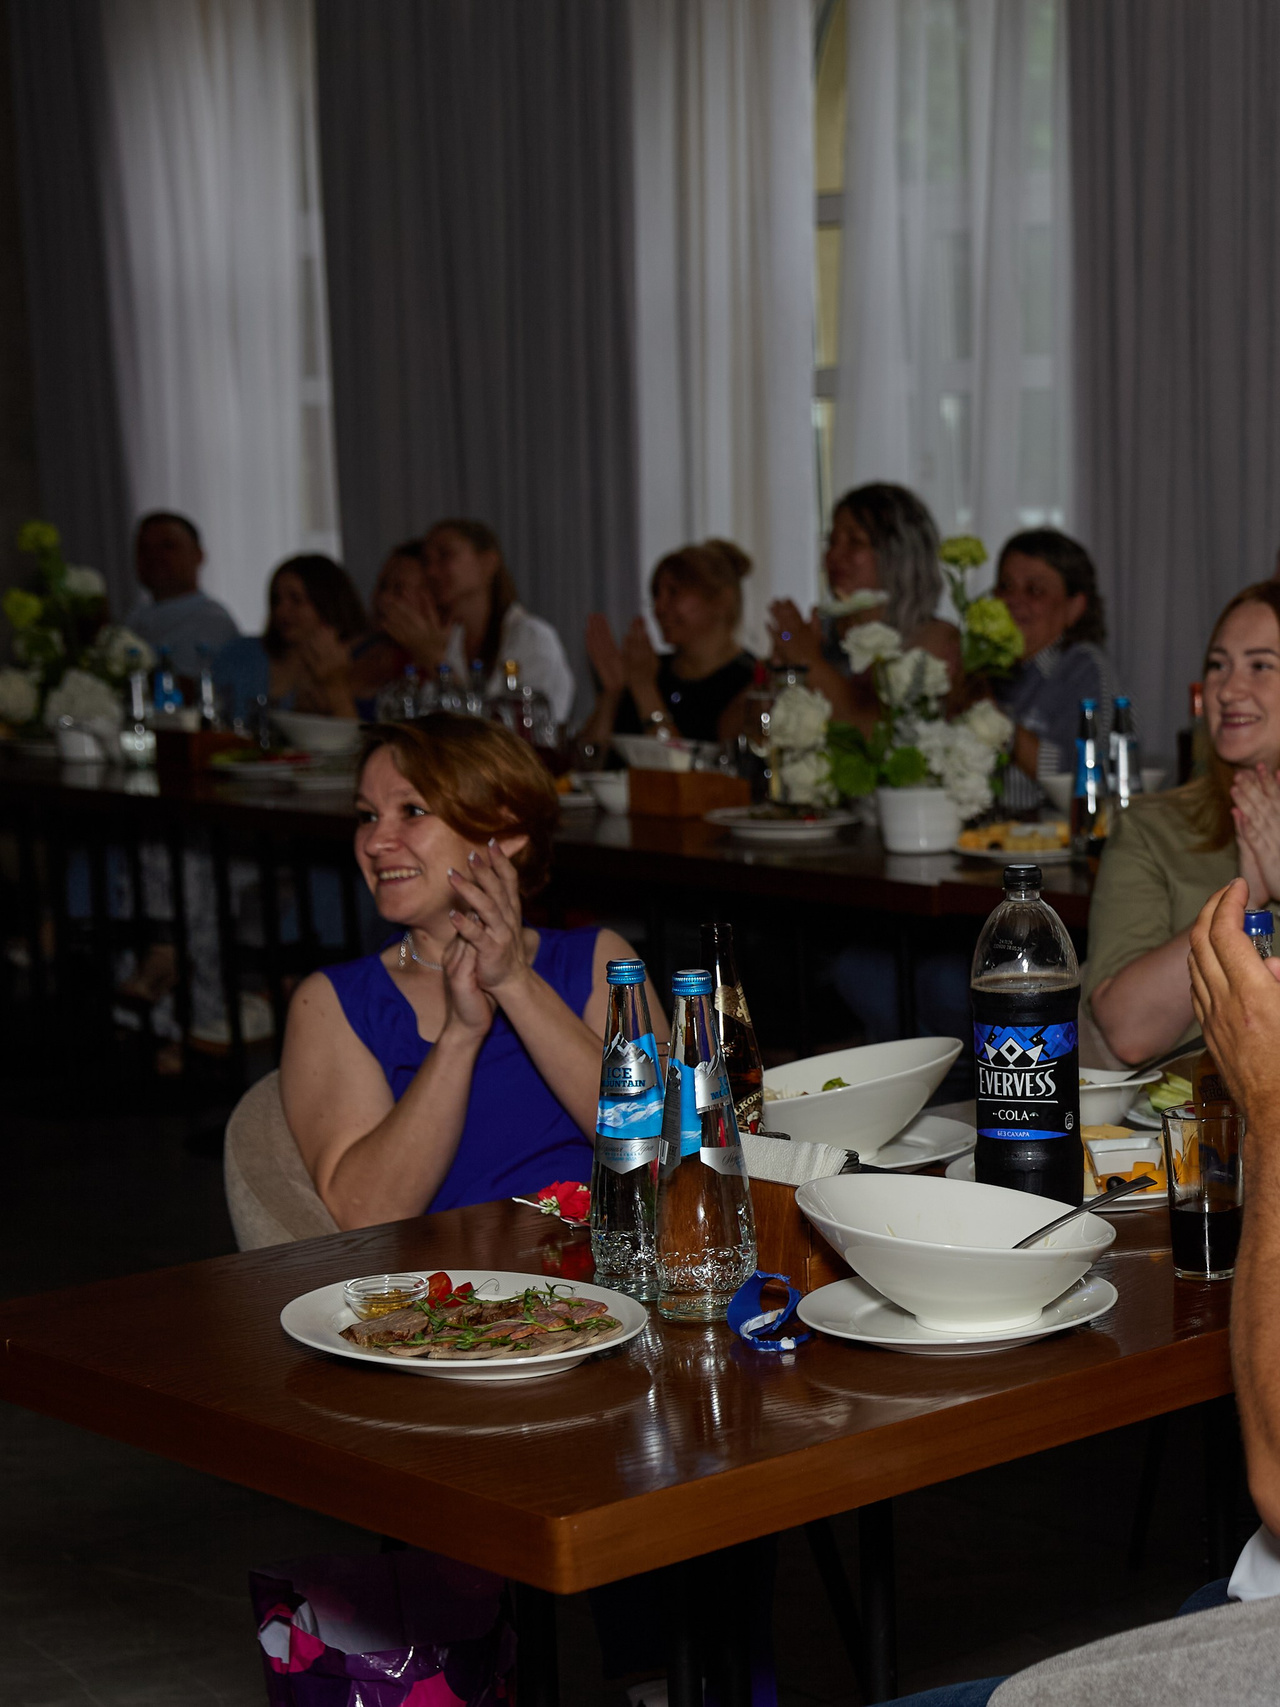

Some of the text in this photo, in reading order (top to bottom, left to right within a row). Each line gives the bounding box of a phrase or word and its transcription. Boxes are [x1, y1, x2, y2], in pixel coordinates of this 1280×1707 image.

[607, 1067, 632, 1079] ICE
[978, 1066, 1057, 1097] EVERVESS
[997, 1109, 1030, 1121] COLA
[1006, 1130, 1030, 1138] САХАРА
